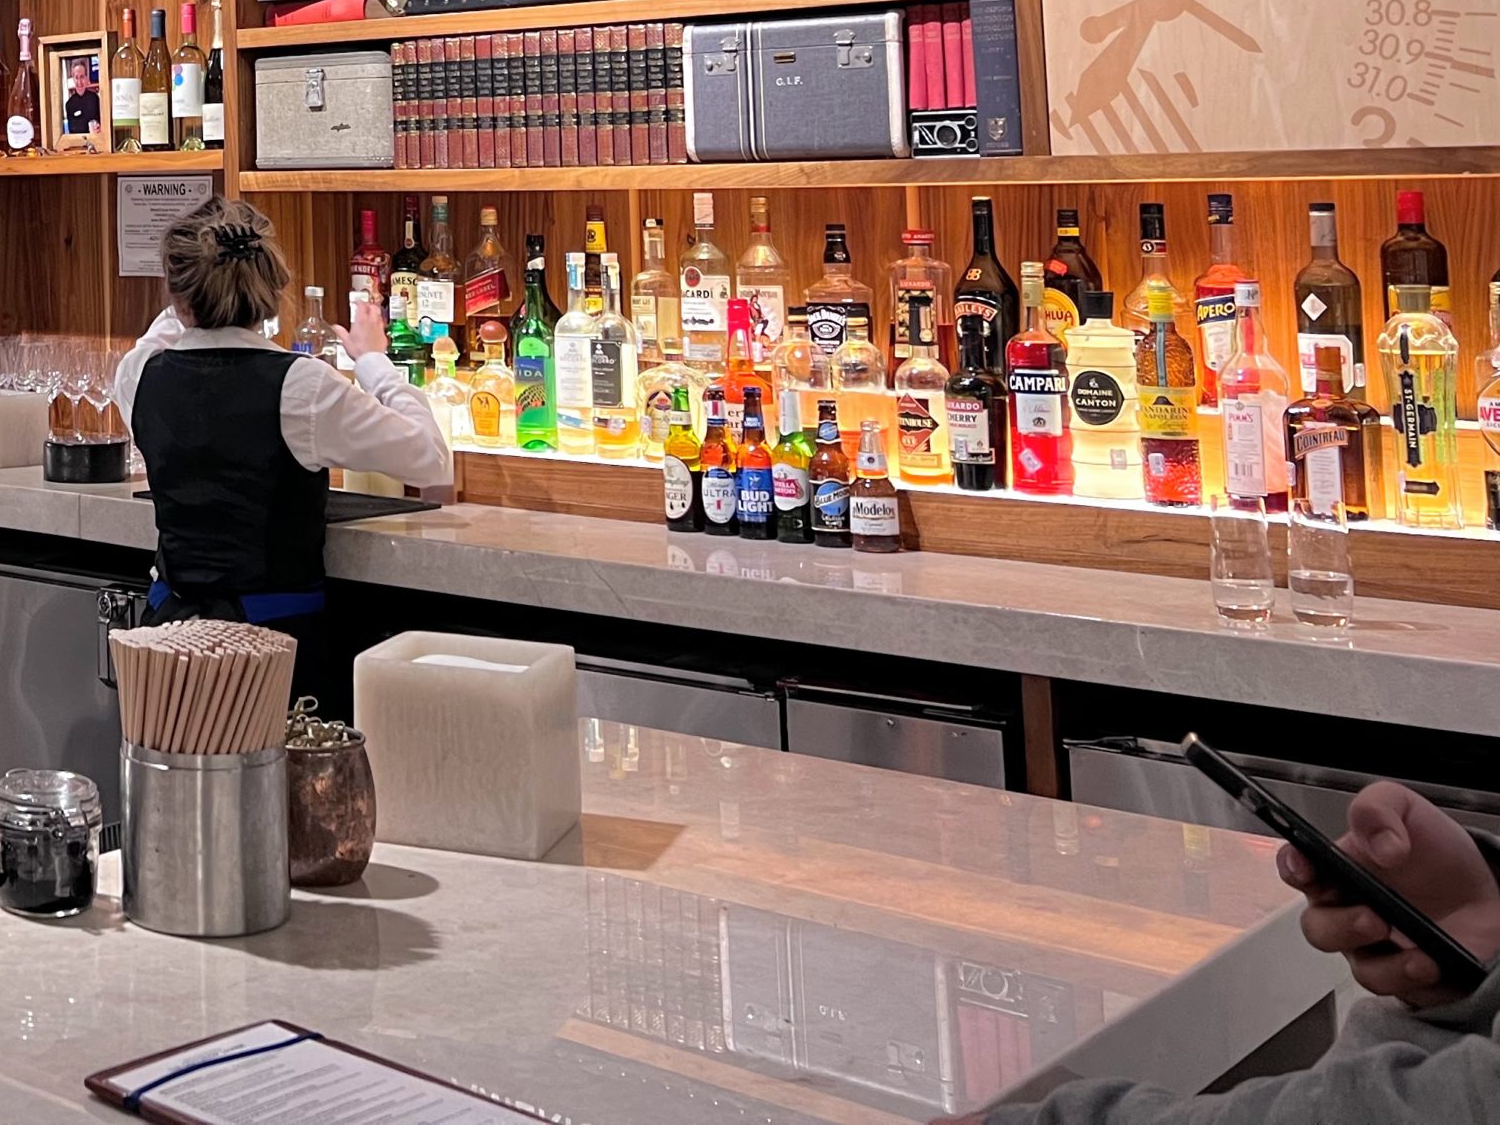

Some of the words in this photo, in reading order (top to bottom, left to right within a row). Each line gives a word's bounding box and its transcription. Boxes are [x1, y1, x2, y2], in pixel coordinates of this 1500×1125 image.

[1358, 28, 1425, 65] 30.9
[1346, 61, 1409, 103] 31.0
[142, 183, 186, 196] WARNING
[1197, 301, 1236, 322] APERO
[1009, 376, 1067, 392] CAMPARI
[1077, 388, 1113, 397] DOMAINE
[1075, 398, 1117, 408] CANTON
[1228, 413, 1254, 423] PIMM'S
[1403, 387, 1418, 449] ST-GERMAIN
[1295, 430, 1346, 453] COINTREAU
[740, 490, 770, 502] BUD
[738, 500, 773, 513] LIGHT
